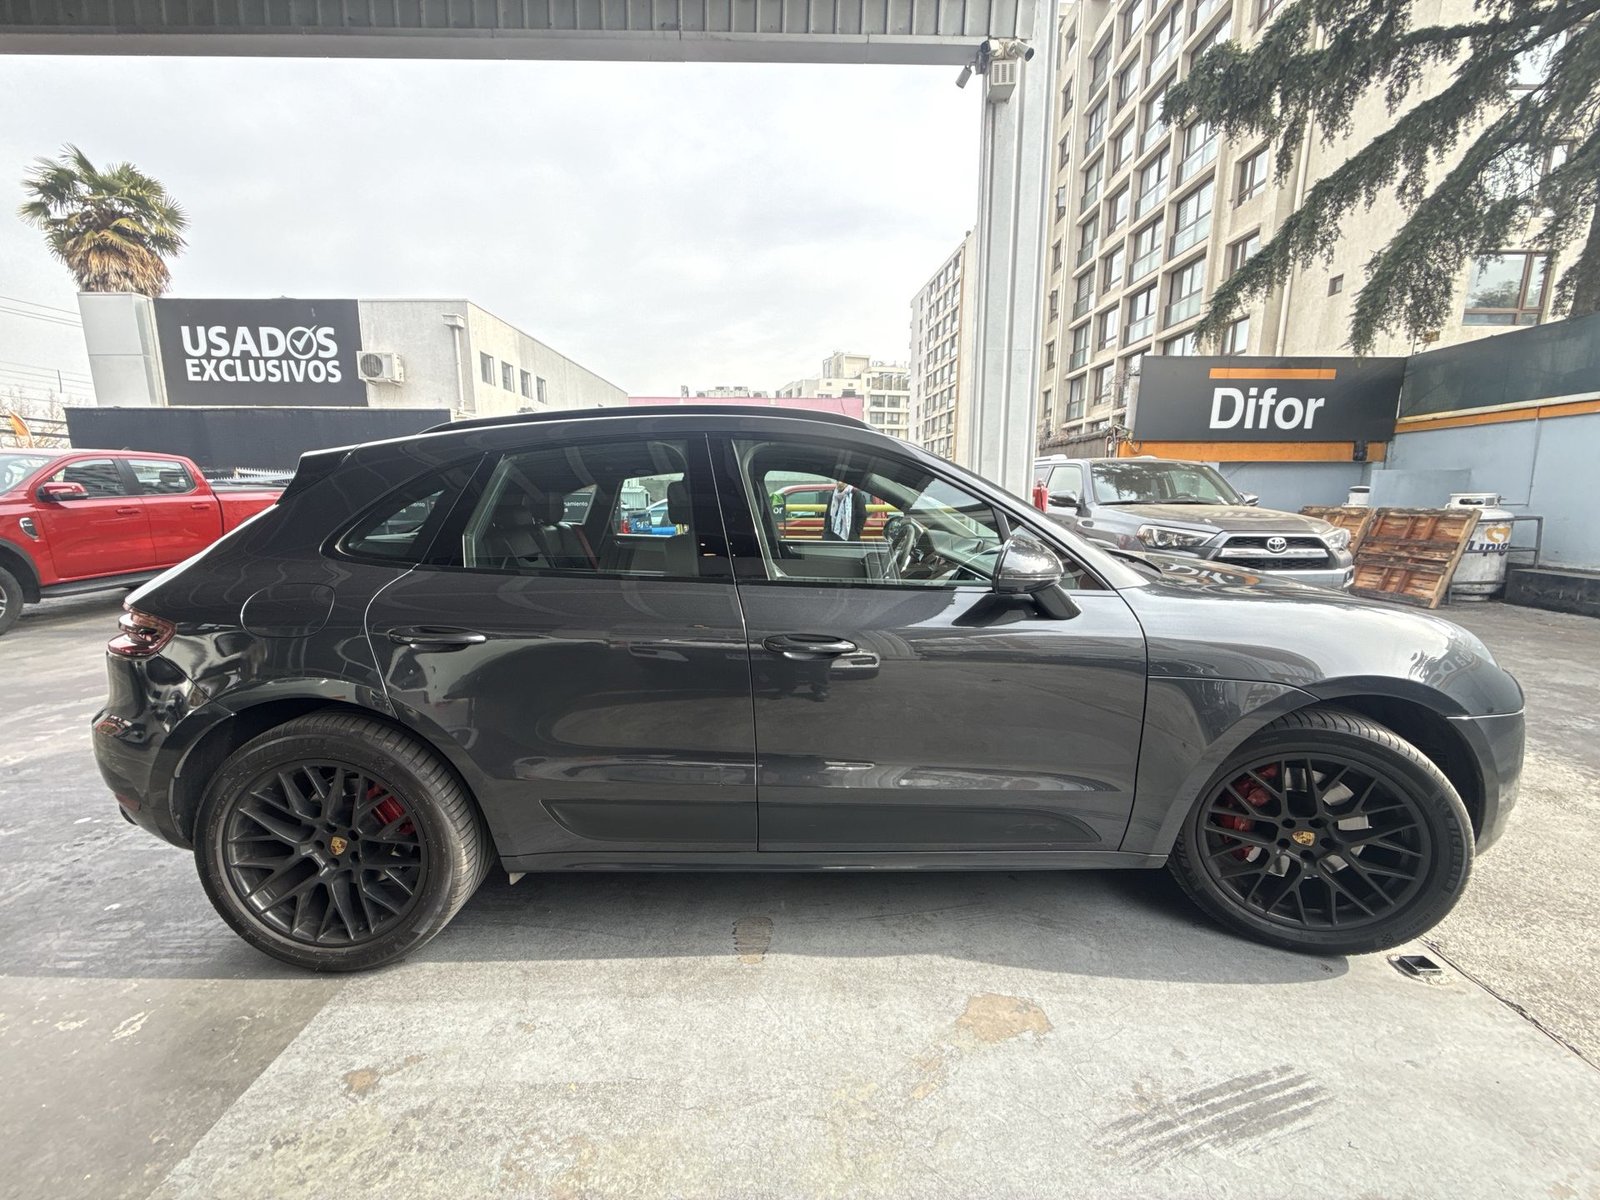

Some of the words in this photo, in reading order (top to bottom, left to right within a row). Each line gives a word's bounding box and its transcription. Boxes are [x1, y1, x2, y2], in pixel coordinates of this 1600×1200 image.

[180, 325, 338, 359] USADOS
[185, 358, 342, 383] EXCLUSIVOS
[1209, 387, 1325, 430] Difor
